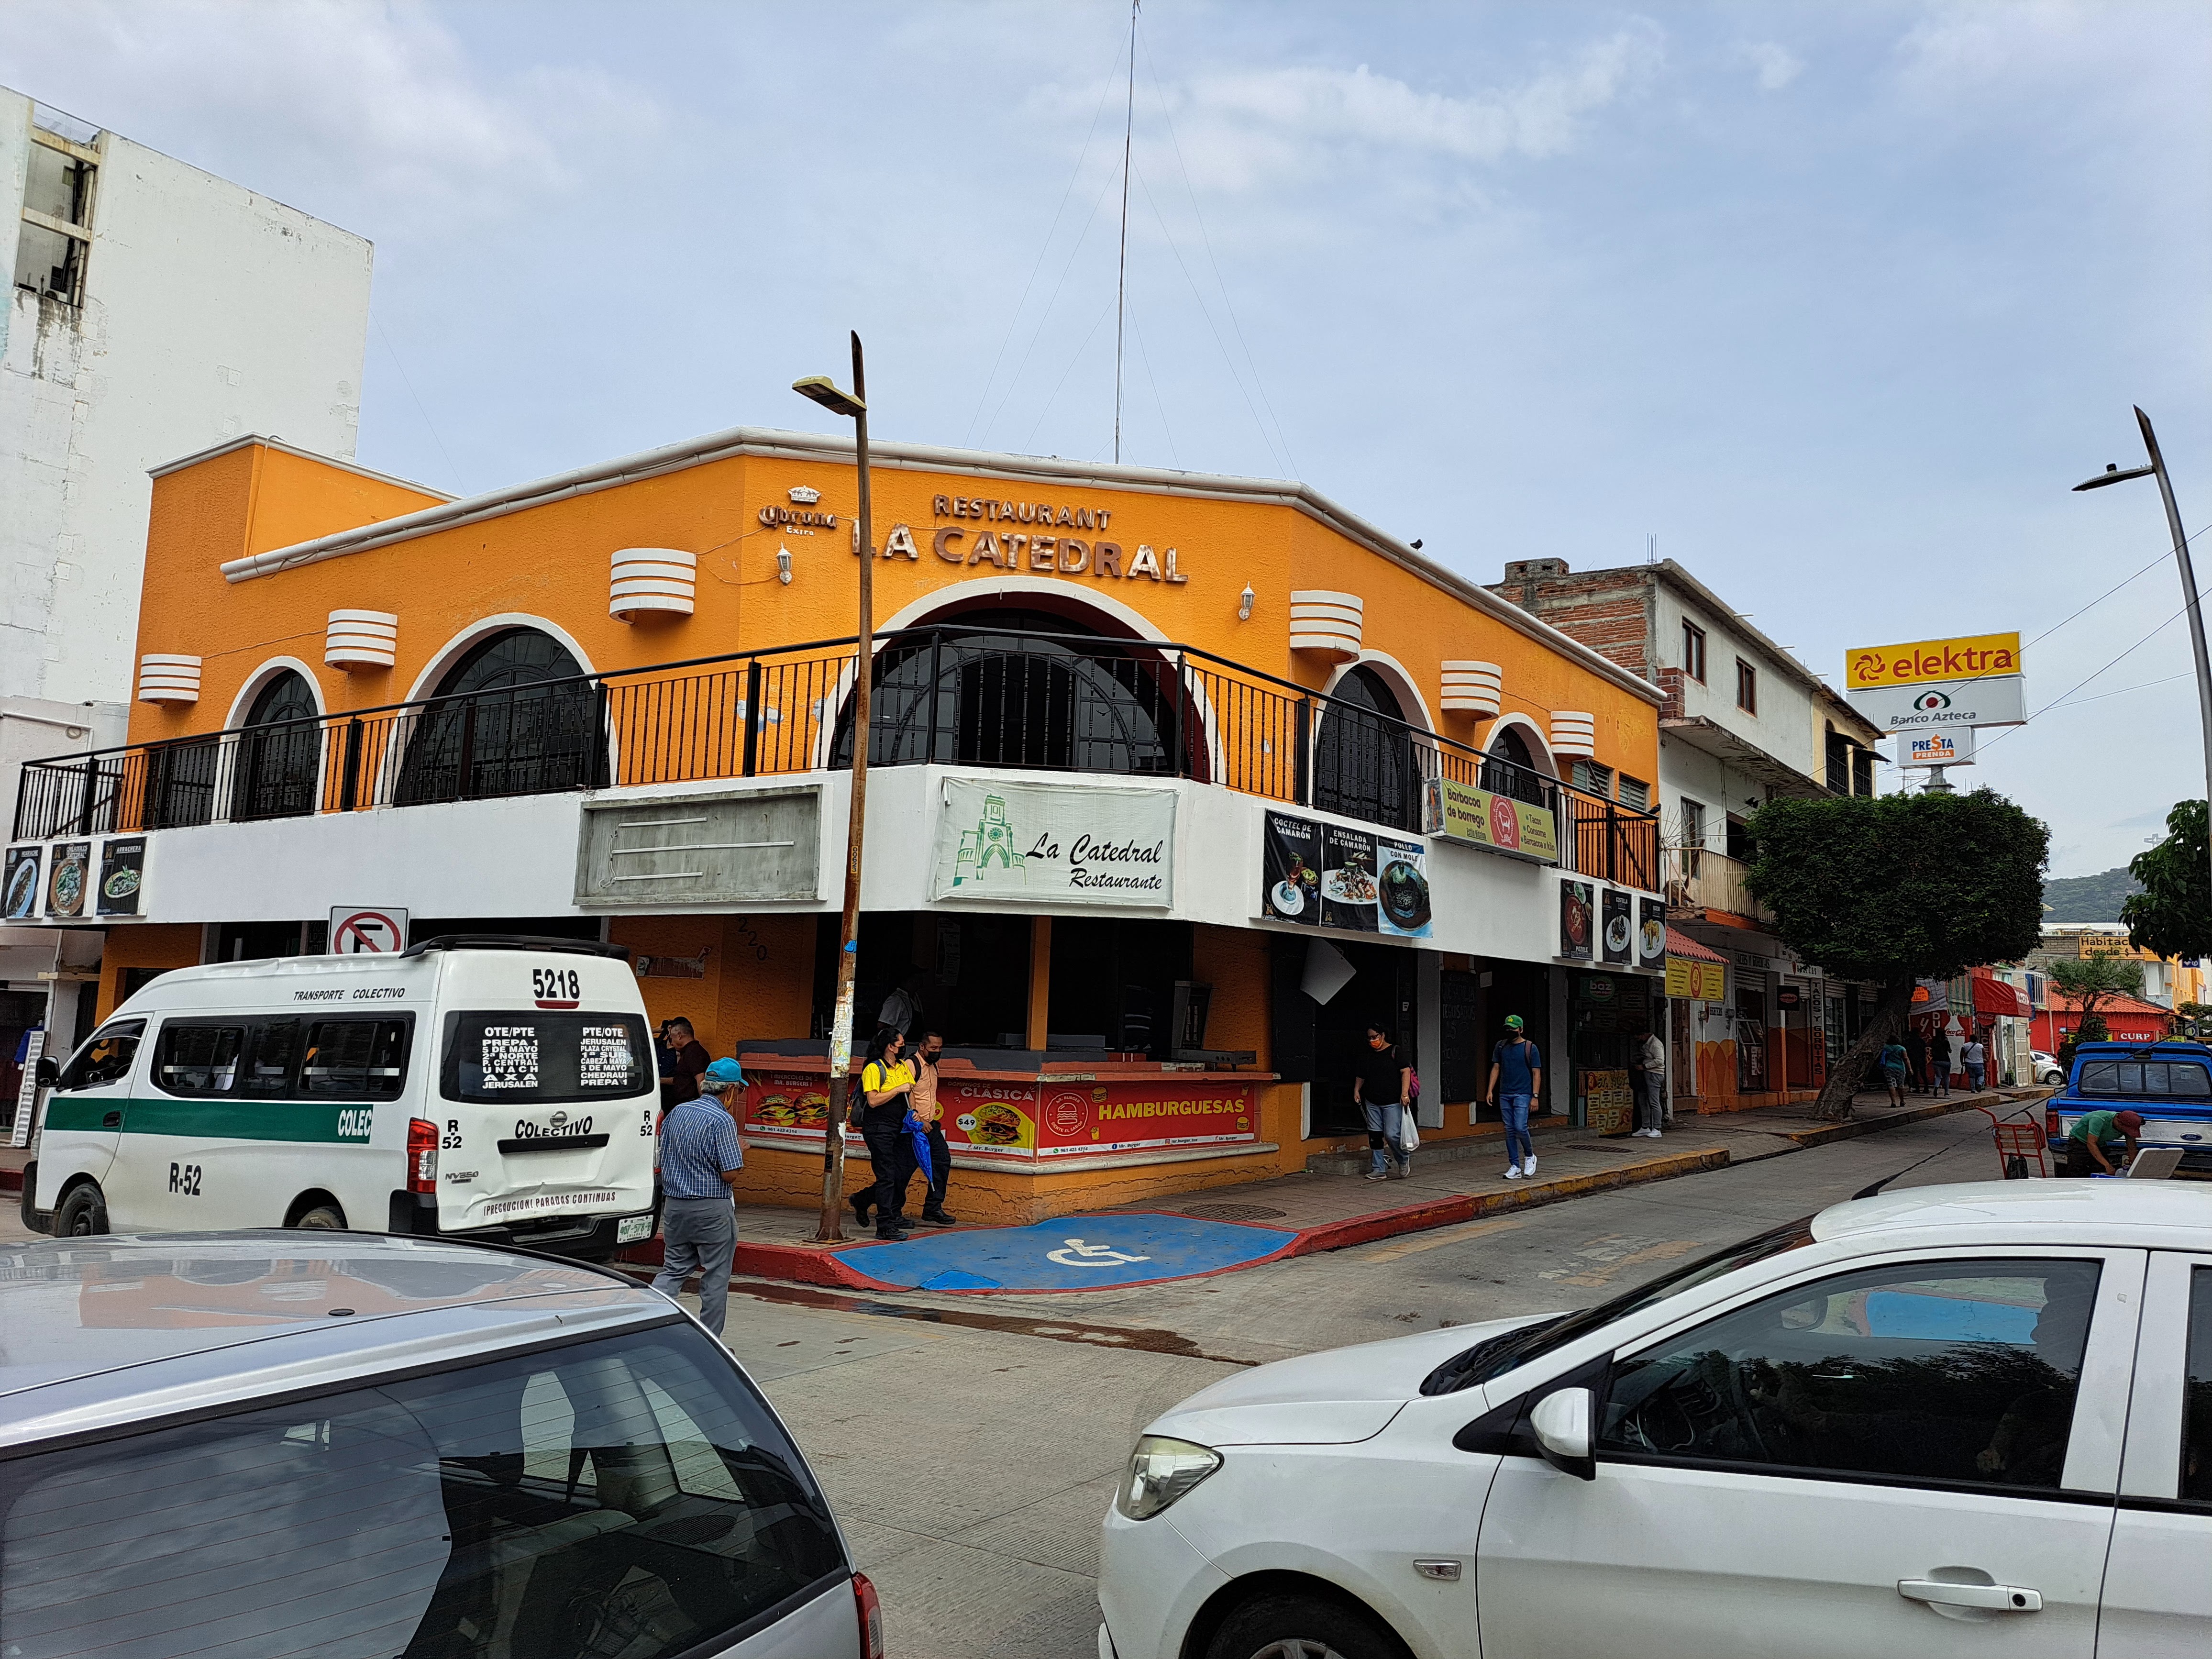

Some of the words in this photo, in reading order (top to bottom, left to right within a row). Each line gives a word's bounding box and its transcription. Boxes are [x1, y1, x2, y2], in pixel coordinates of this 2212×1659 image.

[758, 505, 837, 528] Corona
[934, 493, 1112, 530] RESTAURANT
[786, 525, 814, 536] Extra
[852, 522, 919, 559] LA
[934, 527, 1189, 582] CATEDRAL
[1893, 645, 2013, 677] elektra
[1890, 712, 1929, 725] Banco
[1931, 711, 1976, 722] Azteca
[1447, 788, 1482, 809] Barbacoa
[1447, 805, 1456, 818] de
[1458, 807, 1485, 829] borrego
[1529, 814, 1542, 826] Tacos
[1274, 817, 1301, 831] COCTEL
[1302, 823, 1312, 832] DE
[1526, 824, 1547, 838] Consome
[1277, 826, 1311, 840] CAMARÓN
[1333, 830, 1367, 844] ENSALADA
[1026, 832, 1061, 859] La
[1069, 833, 1163, 865] Catedral
[1329, 837, 1338, 845] DE
[1340, 838, 1371, 852] CAMARÓN
[1394, 841, 1413, 852] POLLO
[1547, 841, 1555, 852] kilo
[1390, 850, 1402, 859] CON
[1069, 867, 1162, 890] Restaurante
[2085, 947, 2120, 956] desde
[532, 969, 580, 999] 5218
[1590, 980, 1612, 990] baz
[293, 990, 344, 1001] TRANSPORTE
[353, 988, 405, 999] COLECTIVO
[1813, 982, 1821, 1012] TACOS
[485, 1027, 535, 1037] OTE/PTE
[583, 1027, 623, 1037] PTE/OTE
[2121, 1032, 2151, 1041] CURP
[1814, 1025, 1823, 1075] GORDITAS
[482, 1081, 538, 1089] JERUSALEN
[961, 1087, 1034, 1101] CLASICA
[1063, 1095, 1081, 1104] BURGER
[1098, 1099, 1245, 1120] HAMBURGUESAS
[338, 1109, 373, 1137] COLEC
[515, 1116, 593, 1139] COLECTIVO
[1051, 1121, 1064, 1133] SIENTE
[1071, 1120, 1084, 1132] SABOR
[640, 1124, 653, 1137] 52
[442, 1136, 462, 1149] 52
[169, 1161, 202, 1196] R-52
[535, 1195, 570, 1208] PARADAS
[572, 1192, 616, 1204] CONTINUAS
